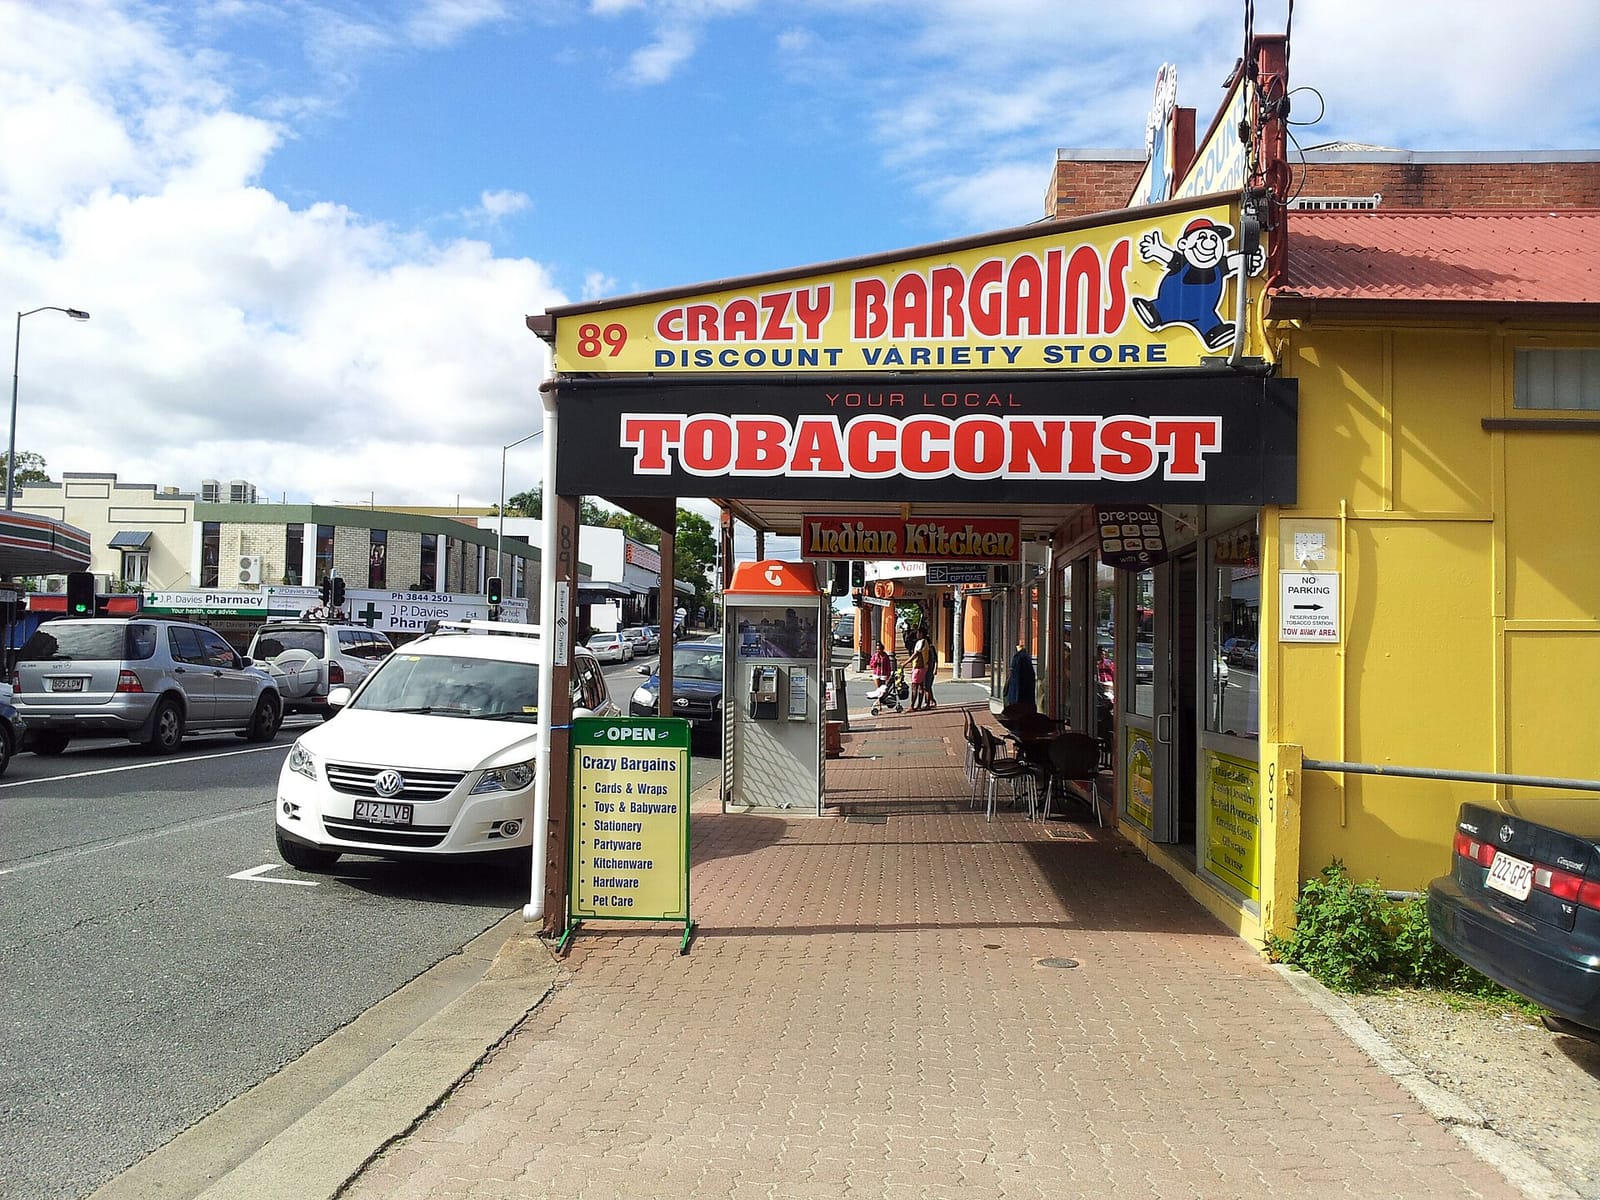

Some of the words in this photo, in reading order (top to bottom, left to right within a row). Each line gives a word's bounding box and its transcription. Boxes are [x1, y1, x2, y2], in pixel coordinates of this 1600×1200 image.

[655, 284, 833, 343] CRAZY
[852, 238, 1130, 339] BARGAINS
[577, 323, 628, 358] 89
[655, 349, 843, 367] DISCOUNT
[862, 346, 1022, 365] VARIETY
[1043, 344, 1167, 363] STORE
[826, 393, 905, 407] YOUR
[923, 393, 1021, 407] LOCAL
[621, 414, 1222, 481] TOBACCONIST
[810, 521, 897, 555] Indian
[904, 522, 1014, 557] Kitchen
[1119, 555, 1137, 564] with
[1301, 576, 1316, 585] NO
[1287, 586, 1330, 595] PARKING
[175, 595, 203, 605] Davies
[205, 594, 264, 607] Pharmacy
[391, 592, 404, 601] Ph
[406, 593, 430, 602] 3844
[432, 594, 453, 603] 2501
[171, 607, 185, 615] Your
[411, 606, 449, 618] Davies
[1283, 628, 1298, 636] TOW
[1299, 628, 1317, 636] AWAY
[1318, 629, 1337, 637] AREA
[607, 727, 656, 741] OPEN
[582, 756, 617, 771] Crazy
[621, 757, 676, 772] Bargains
[595, 782, 622, 794] Cards
[626, 783, 633, 794] &
[637, 783, 668, 796] Wraps
[594, 801, 615, 813] Toys
[618, 801, 626, 813] &
[630, 802, 677, 814] Babyware
[594, 819, 642, 833] Stationery
[594, 838, 642, 851] Partyware
[593, 857, 653, 870] Kitchenware
[593, 876, 639, 888] Hardware
[593, 895, 608, 907] Pet
[611, 895, 633, 907] Care
